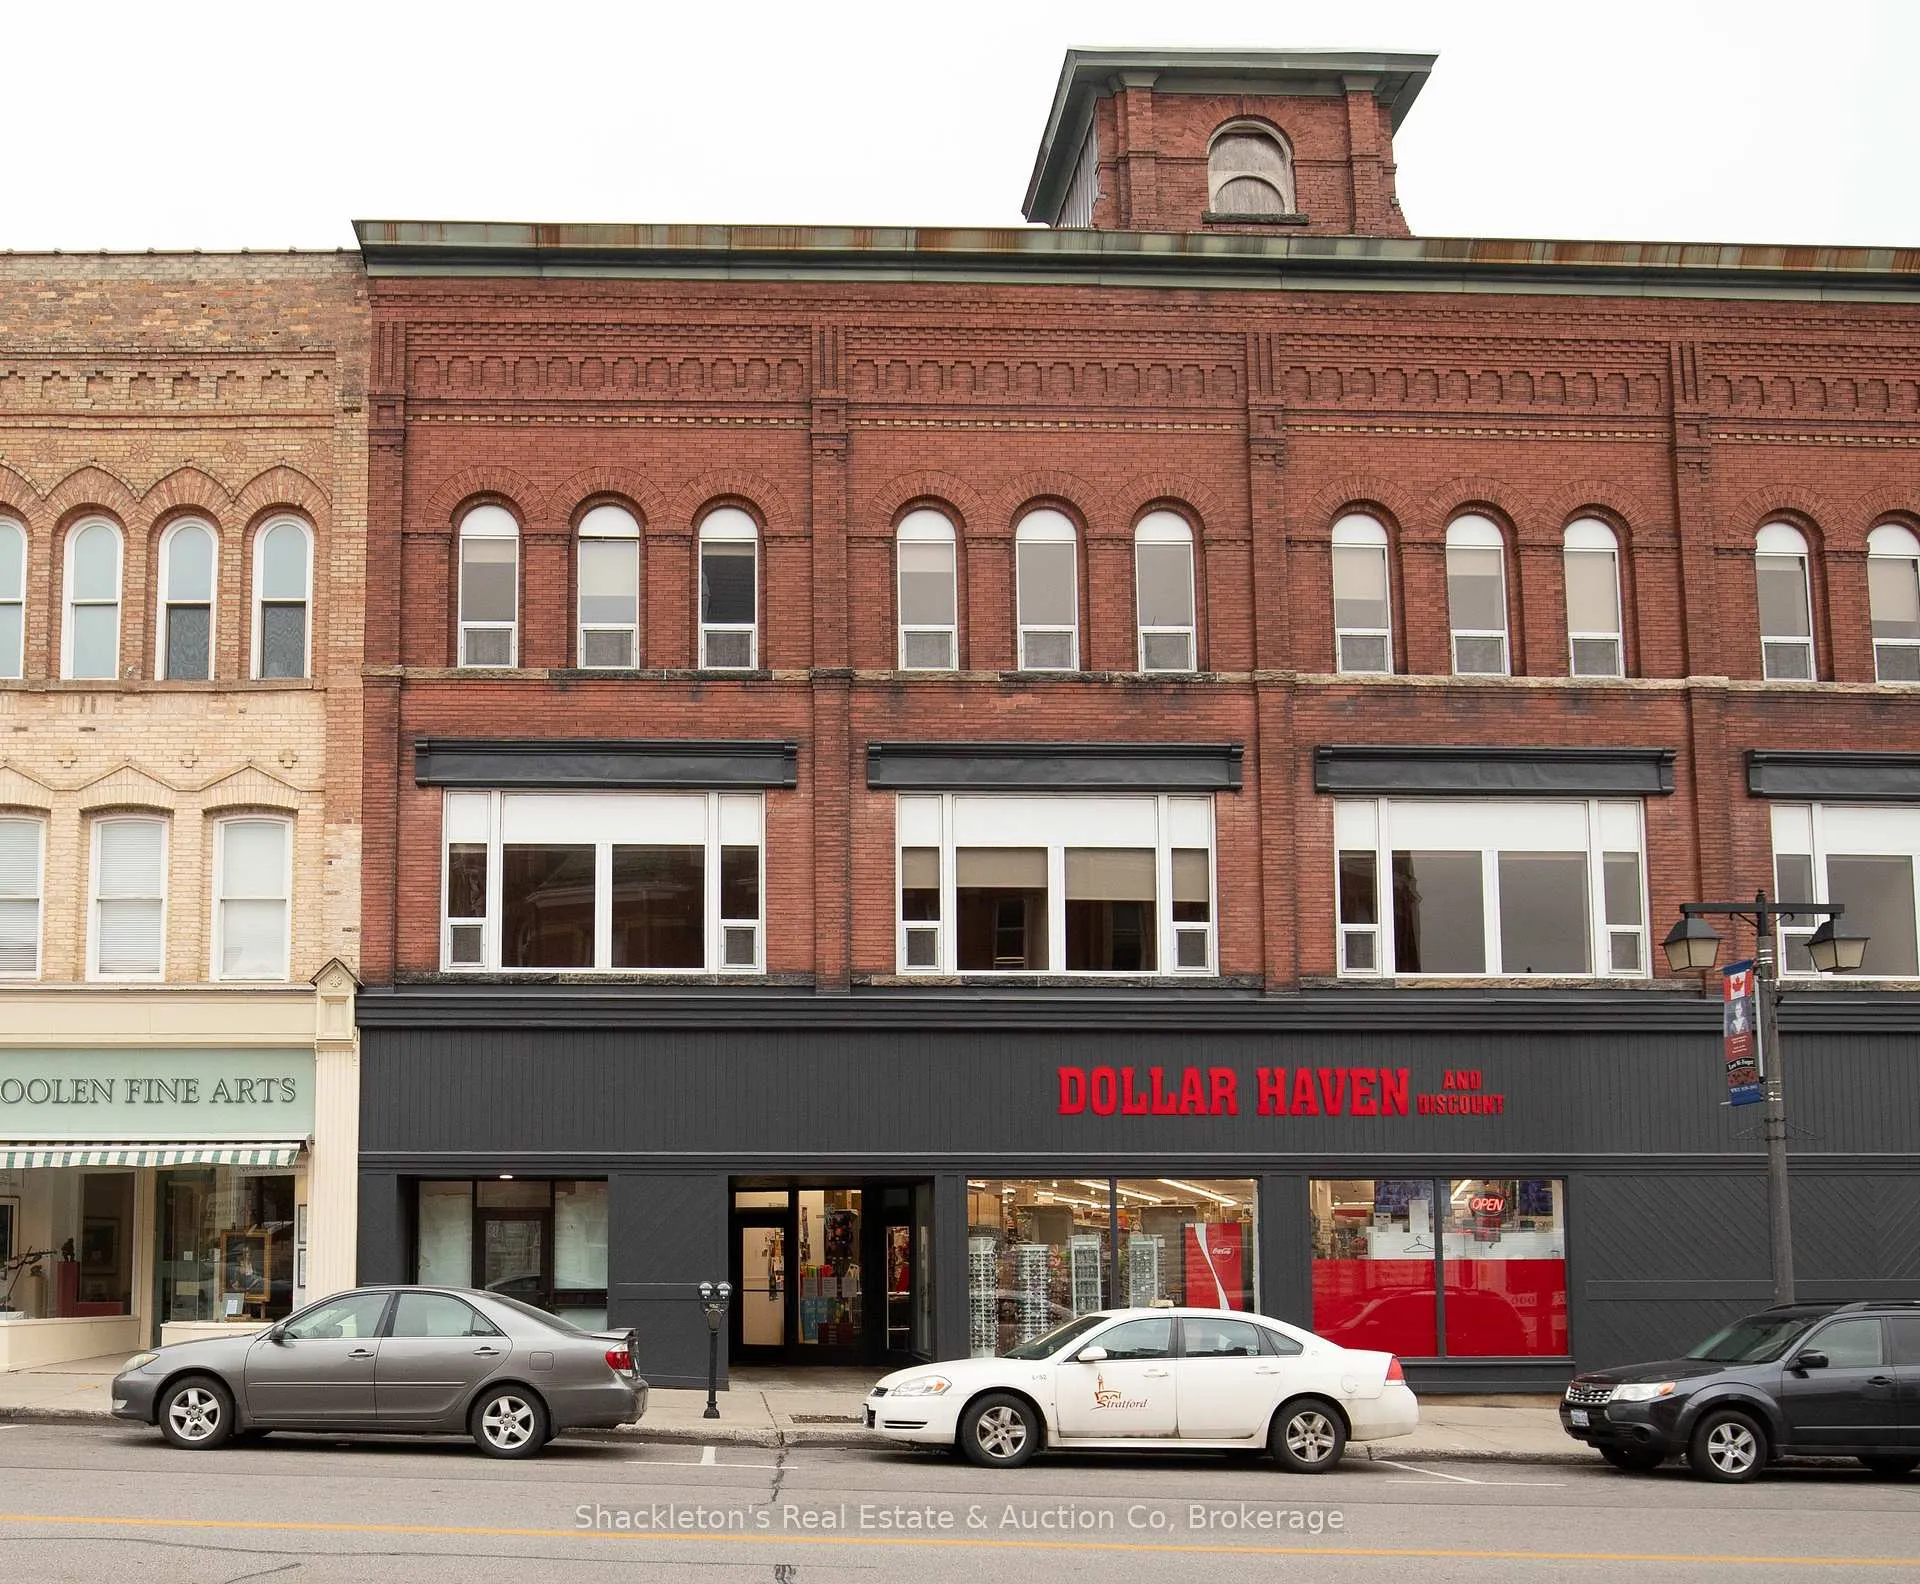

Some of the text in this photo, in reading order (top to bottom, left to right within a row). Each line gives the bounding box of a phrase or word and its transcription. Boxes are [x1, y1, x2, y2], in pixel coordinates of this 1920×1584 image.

[0, 1077, 296, 1104] OOLEN FINE ARTS
[1057, 1065, 1411, 1117] DOLLAR HAVEN
[1442, 1069, 1482, 1091] AND
[1416, 1093, 1504, 1116] DISCOUNT
[1471, 1198, 1504, 1211] OPEN
[1090, 1399, 1148, 1411] Stratford
